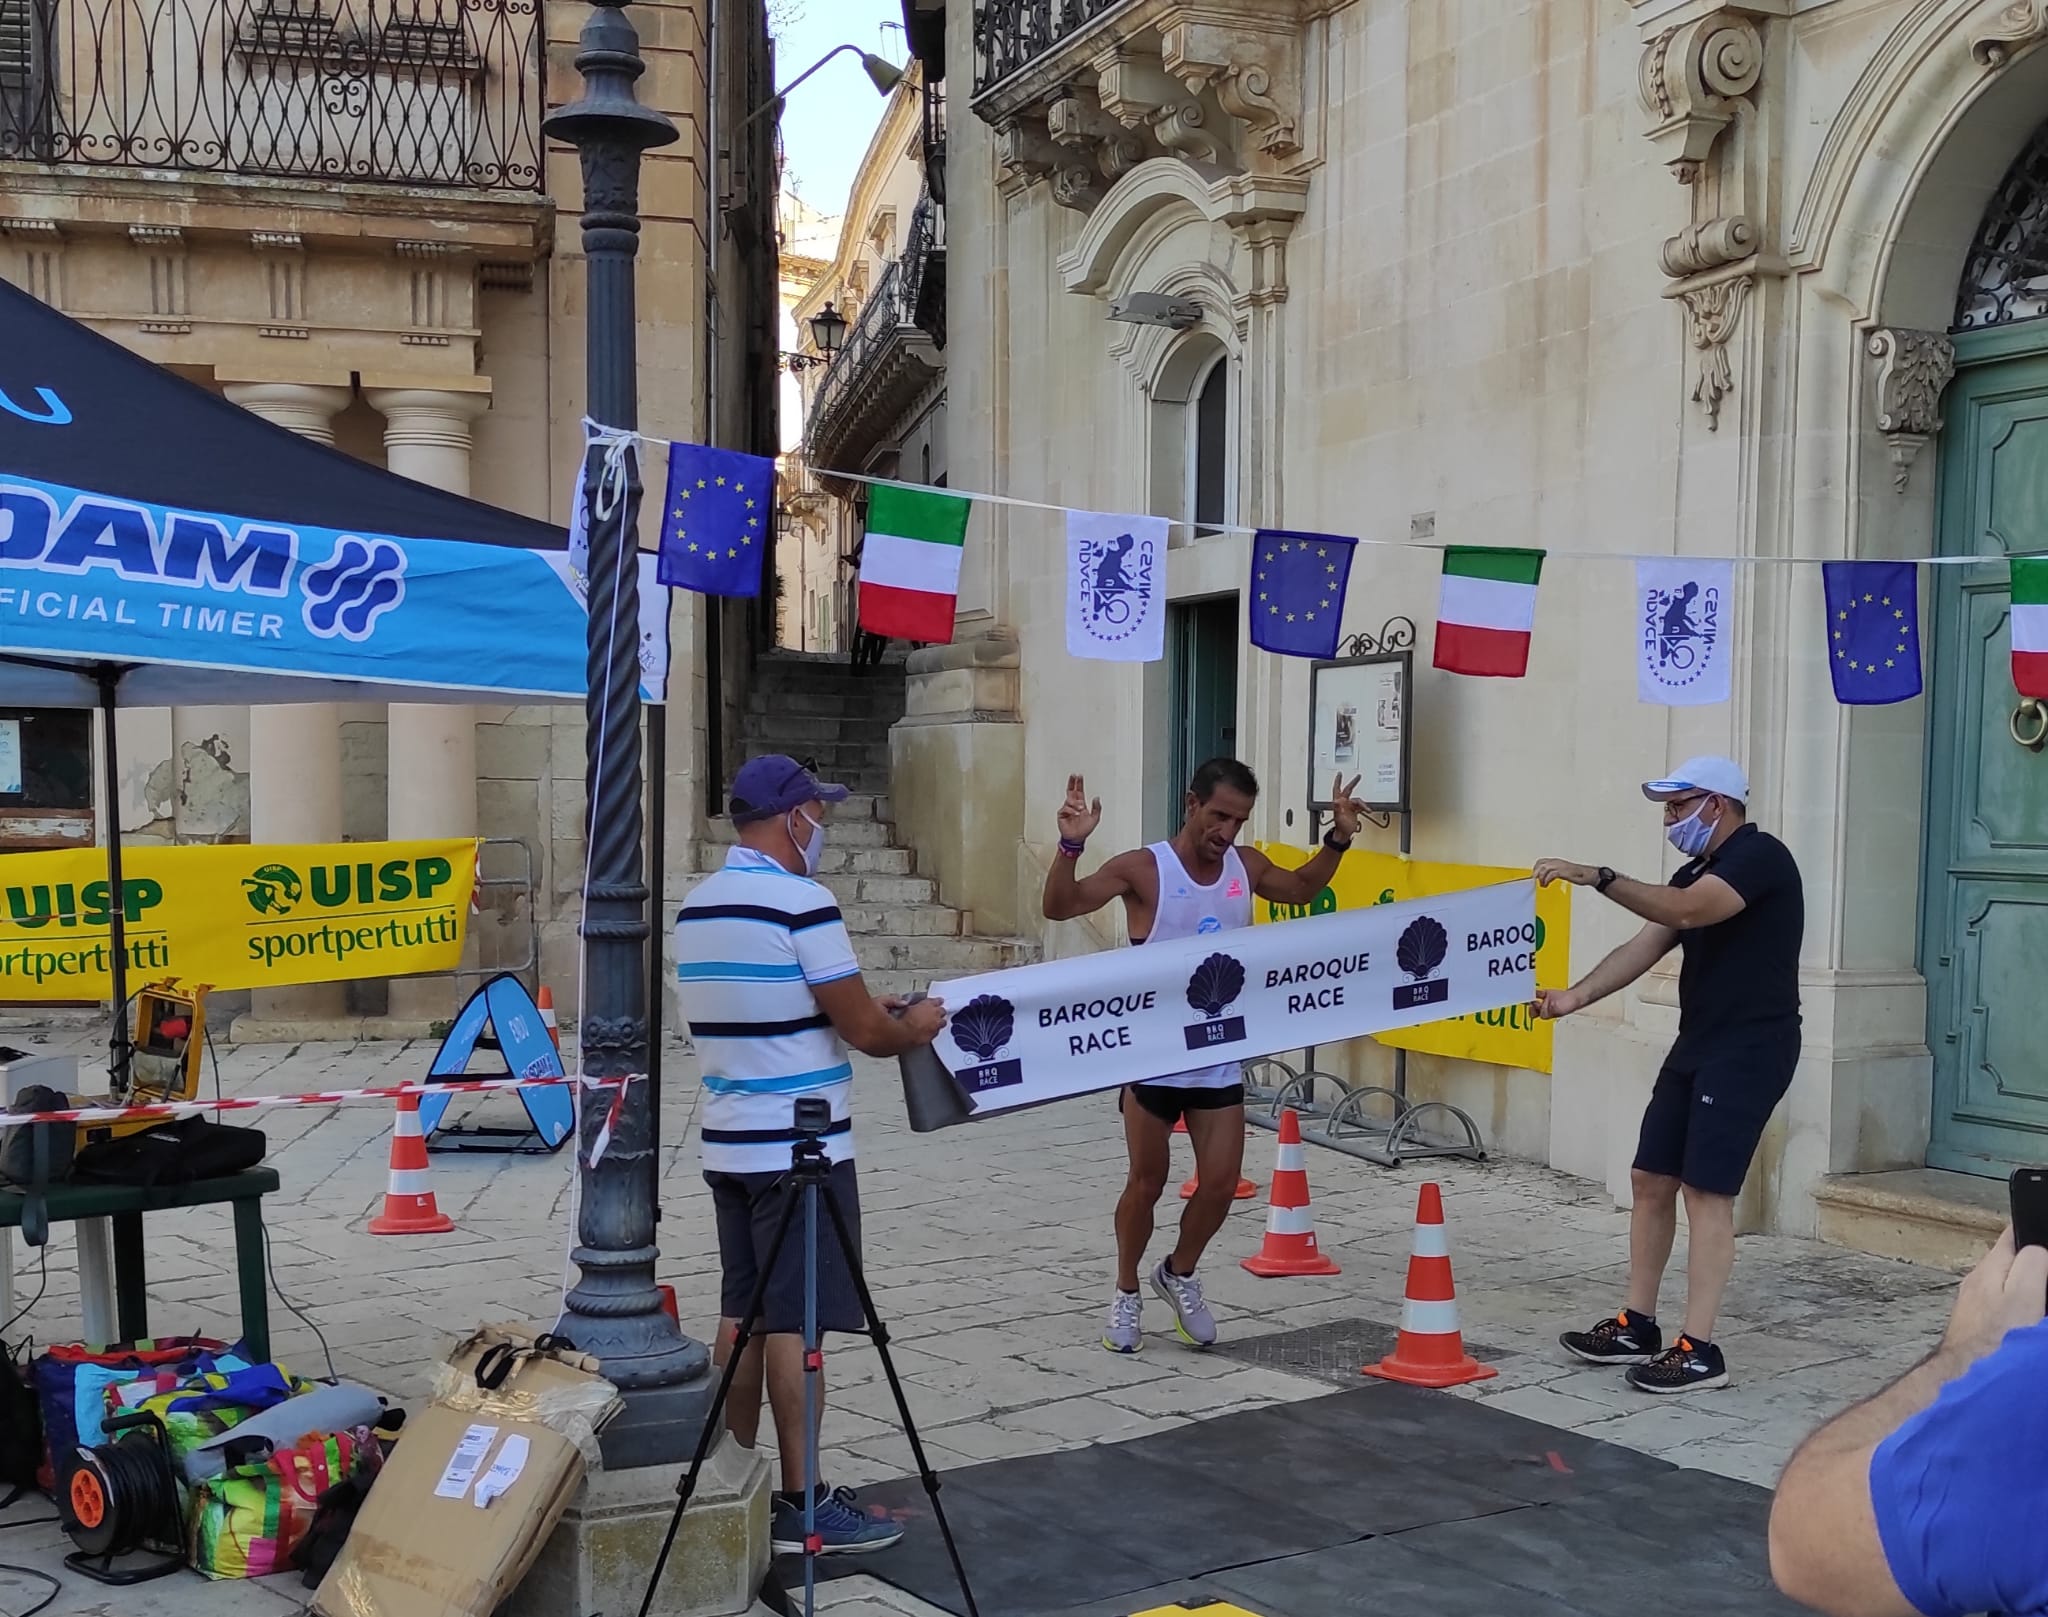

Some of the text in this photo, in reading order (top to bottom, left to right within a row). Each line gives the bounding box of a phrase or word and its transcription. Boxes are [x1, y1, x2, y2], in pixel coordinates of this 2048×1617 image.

[157, 602, 285, 640] TIMER
[309, 856, 453, 908] UISP
[5, 878, 164, 929] UISP
[248, 909, 457, 968] sportpertutti
[0, 935, 169, 985] rtperttti
[1264, 952, 1371, 990] BAROQUE
[1038, 990, 1157, 1028] BAROQUE
[1288, 986, 1345, 1014] RACE
[1068, 1025, 1132, 1057] RACE
[1208, 1033, 1226, 1042] RACE
[979, 1076, 999, 1087] RACE
